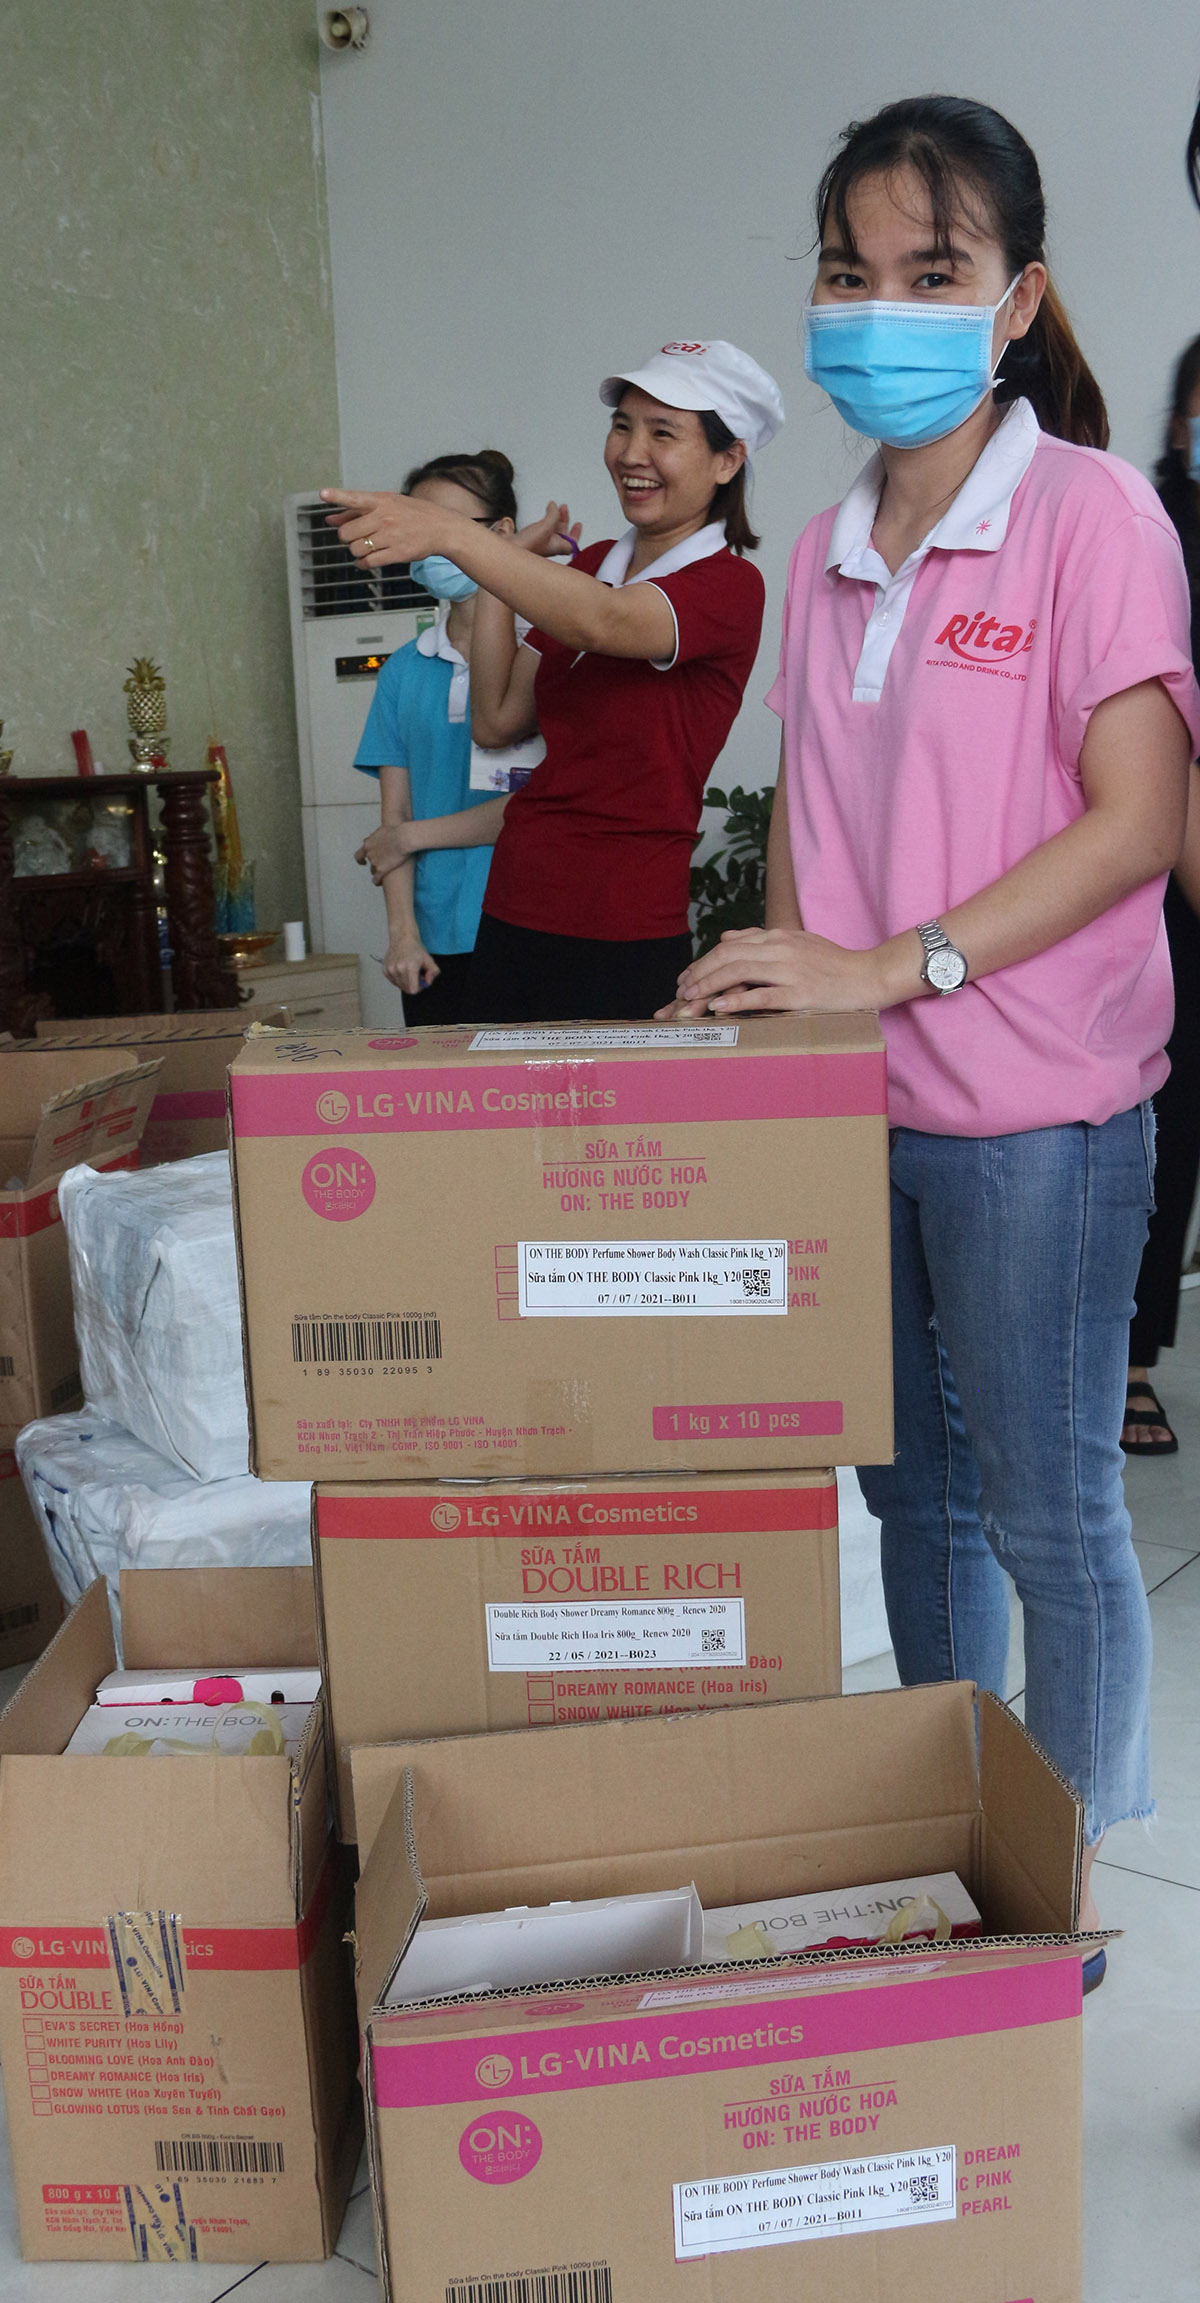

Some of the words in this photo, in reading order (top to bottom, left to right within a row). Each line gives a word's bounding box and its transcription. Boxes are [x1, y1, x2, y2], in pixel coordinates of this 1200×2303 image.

[934, 611, 1031, 663] Rita
[940, 661, 959, 669] FOOD
[959, 663, 975, 672] AND
[976, 666, 999, 676] DRINK
[356, 1090, 475, 1117] LG-VINA
[482, 1085, 616, 1112] Cosmetics
[585, 1138, 618, 1160] SỮA
[626, 1135, 662, 1158] TẮM
[310, 1163, 366, 1188] ON:
[543, 1168, 605, 1189] HƯƠNG
[613, 1164, 662, 1186] NƯỚC
[671, 1166, 708, 1185] HOA
[313, 1189, 333, 1199] THE
[336, 1188, 365, 1199] BODY
[560, 1194, 591, 1212] ON:
[598, 1192, 634, 1210] THE
[642, 1190, 690, 1209] BODY
[529, 1248, 543, 1259] ON
[545, 1248, 562, 1258] THE
[566, 1248, 590, 1258] BODY
[593, 1248, 625, 1259] Perfume
[627, 1248, 655, 1258] Shower
[657, 1248, 676, 1261] Body
[679, 1248, 700, 1258] Wash
[702, 1248, 728, 1258] Classic
[730, 1248, 748, 1258] Pink
[528, 1271, 546, 1283] Sữa
[548, 1268, 565, 1283] tắm
[568, 1271, 584, 1283] ON
[586, 1271, 609, 1283] THE
[612, 1271, 642, 1283] BODY
[644, 1271, 676, 1282] Classic
[679, 1271, 699, 1282] Pink
[598, 1294, 610, 1304] 07
[619, 1294, 631, 1304] 07
[669, 1413, 679, 1431] 1
[689, 1412, 710, 1434] kg
[719, 1415, 729, 1430] x
[737, 1410, 760, 1428] 10
[769, 1412, 800, 1432] pcs
[467, 1505, 571, 1527] LG-VINA
[577, 1501, 698, 1524] Cosmetics
[521, 1546, 556, 1566] SỮA
[562, 1542, 600, 1565] TẮM
[522, 1565, 649, 1594] DOUBLE
[663, 1562, 741, 1590] RICH
[494, 1609, 519, 1618] Double
[521, 1609, 538, 1618] Rich
[540, 1608, 558, 1620] Body
[561, 1608, 588, 1617] Shower
[590, 1607, 619, 1619] Dreamy
[621, 1607, 655, 1616] Romance
[657, 1606, 675, 1618] 800g
[682, 1605, 707, 1615] Renew
[709, 1605, 726, 1614] 2020
[530, 1631, 559, 1640] Double
[561, 1631, 579, 1640] Rich
[582, 1630, 599, 1639] Hoa
[601, 1630, 615, 1639] Iris
[643, 1629, 669, 1638] Renew
[672, 1628, 691, 1637] 2020
[548, 1652, 561, 1661] 22
[571, 1651, 584, 1660] 05
[557, 1682, 618, 1697] DREAMY
[625, 1680, 695, 1695] ROMANCE
[701, 1680, 733, 1695] (Hoa
[740, 1679, 767, 1694] Iris)
[19, 1975, 44, 1989] SỮA
[49, 1973, 76, 1989] TẮM
[21, 1991, 113, 2010] DOUBLE
[45, 2021, 75, 2031] EVA'S
[80, 2021, 120, 2032] SECRET
[125, 2021, 149, 2033] (Hoa
[153, 2021, 184, 2034] Hồng)
[47, 2038, 81, 2048] WHITE
[85, 2038, 122, 2048] PURITY
[127, 2038, 151, 2050] (Hoa
[155, 2038, 177, 2050] Lily)
[521, 2041, 651, 2080] LG-VINA
[658, 2022, 804, 2060] Cosmetics
[49, 2055, 103, 2065] BLOOMING
[108, 2055, 134, 2065] LOVE
[138, 2055, 162, 2067] (Hoa
[166, 2056, 185, 2066] Anh
[190, 2056, 214, 2067] Đào)
[51, 2071, 95, 2081] DREAMY
[100, 2072, 151, 2081] ROMANCE
[156, 2072, 179, 2083] (Hoa
[183, 2072, 204, 2083] Iris)
[770, 2074, 805, 2095] SỮA
[812, 2066, 850, 2089] TẮM
[52, 2087, 83, 2098] SNOW
[88, 2088, 121, 2098] WHITE
[126, 2088, 149, 2099] (Hoa
[154, 2088, 185, 2100] Xuyên
[189, 2088, 221, 2101] Tuyết)
[54, 2104, 103, 2114] GLOWING
[108, 2104, 140, 2114] LOTUS
[144, 2105, 168, 2116] (Hoa
[172, 2105, 191, 2115] Sen
[196, 2105, 203, 2115] &
[261, 2106, 286, 2117] Gạo)
[724, 2104, 790, 2129] HƯƠNG
[800, 2094, 851, 2118] NƯỚC
[860, 2089, 898, 2110] HOA
[468, 2124, 532, 2152] ON:
[743, 2130, 775, 2150] ON:
[784, 2123, 821, 2143] THE
[830, 2114, 880, 2137] BODY
[472, 2153, 495, 2164] THE
[497, 2150, 530, 2162] BODY
[964, 2143, 1020, 2165] DREAM
[685, 2187, 699, 2198] ON
[701, 2185, 720, 2196] THE
[723, 2181, 750, 2193] BODY
[752, 2176, 786, 2189] Perfume
[788, 2171, 818, 2184] Shower
[820, 2167, 841, 2180] Body
[843, 2163, 865, 2175] Wash
[867, 2159, 894, 2172] Classic
[897, 2156, 915, 2168] Pink
[976, 2170, 1012, 2189] PINK
[684, 2210, 703, 2222] Sữa
[705, 2204, 724, 2219] tắm
[726, 2204, 743, 2216] ON
[746, 2200, 769, 2213] THE
[773, 2195, 804, 2210] BODY
[807, 2190, 840, 2205] Classic
[843, 2187, 865, 2199] Pink
[961, 2196, 1012, 2216] PEARL
